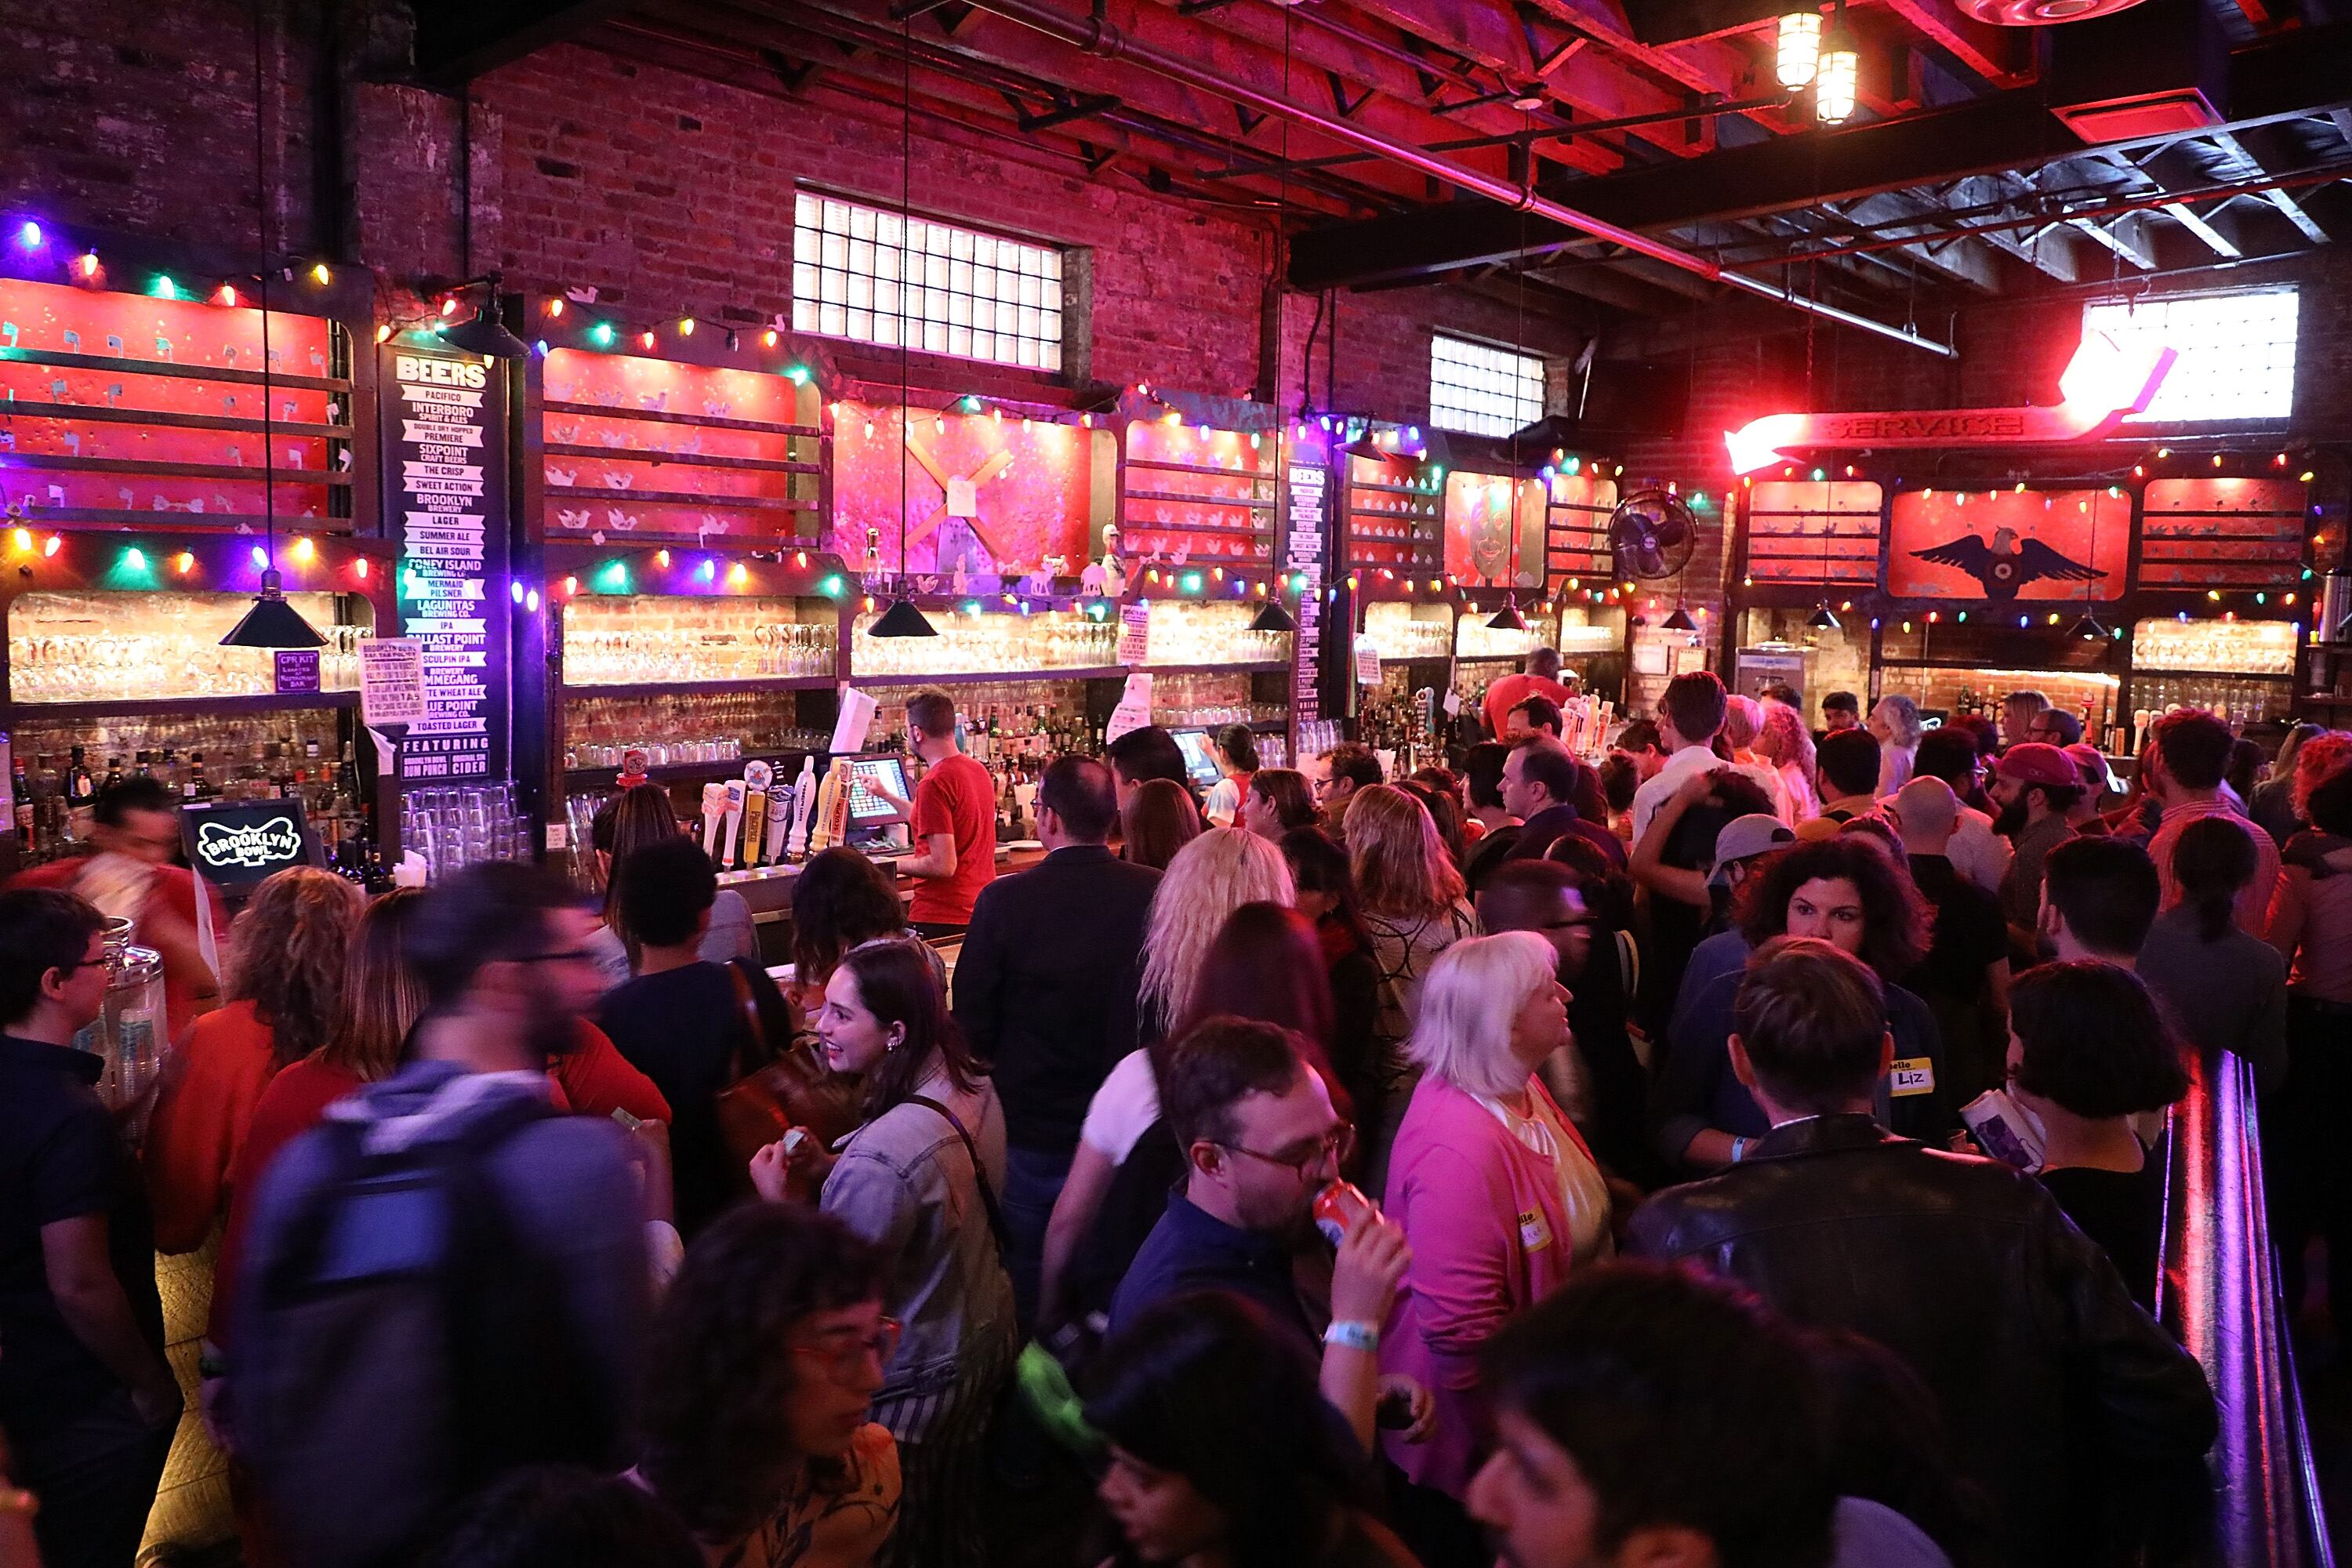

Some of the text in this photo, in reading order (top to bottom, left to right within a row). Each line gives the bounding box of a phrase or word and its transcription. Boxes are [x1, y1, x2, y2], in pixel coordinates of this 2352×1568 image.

[397, 356, 486, 388] BEERS
[426, 391, 461, 401] PACIFICO
[412, 402, 474, 417] INTERBORO
[1827, 415, 2024, 439] SERVICE
[425, 433, 463, 443] PREMIERE
[419, 444, 469, 457] SIXPOINT
[425, 466, 439, 474] THE
[416, 481, 473, 492] SWEET ACTION
[417, 494, 472, 506] BROOKLYN
[433, 517, 459, 525] LAGER
[420, 532, 470, 541] SUMMER ALE
[445, 561, 481, 571] ISLAND
[417, 601, 475, 611] LAGUNITAS
[407, 633, 485, 644] LLAST POINT
[424, 674, 477, 685] MMEGANG
[446, 701, 477, 710] POINT
[417, 722, 452, 731] TOASTED
[403, 738, 488, 753] FEATURING
[452, 761, 485, 774] CIDER
[206, 833, 292, 857] BROOKLYN
[236, 845, 273, 858] BOWL
[1518, 1214, 1533, 1223] llo
